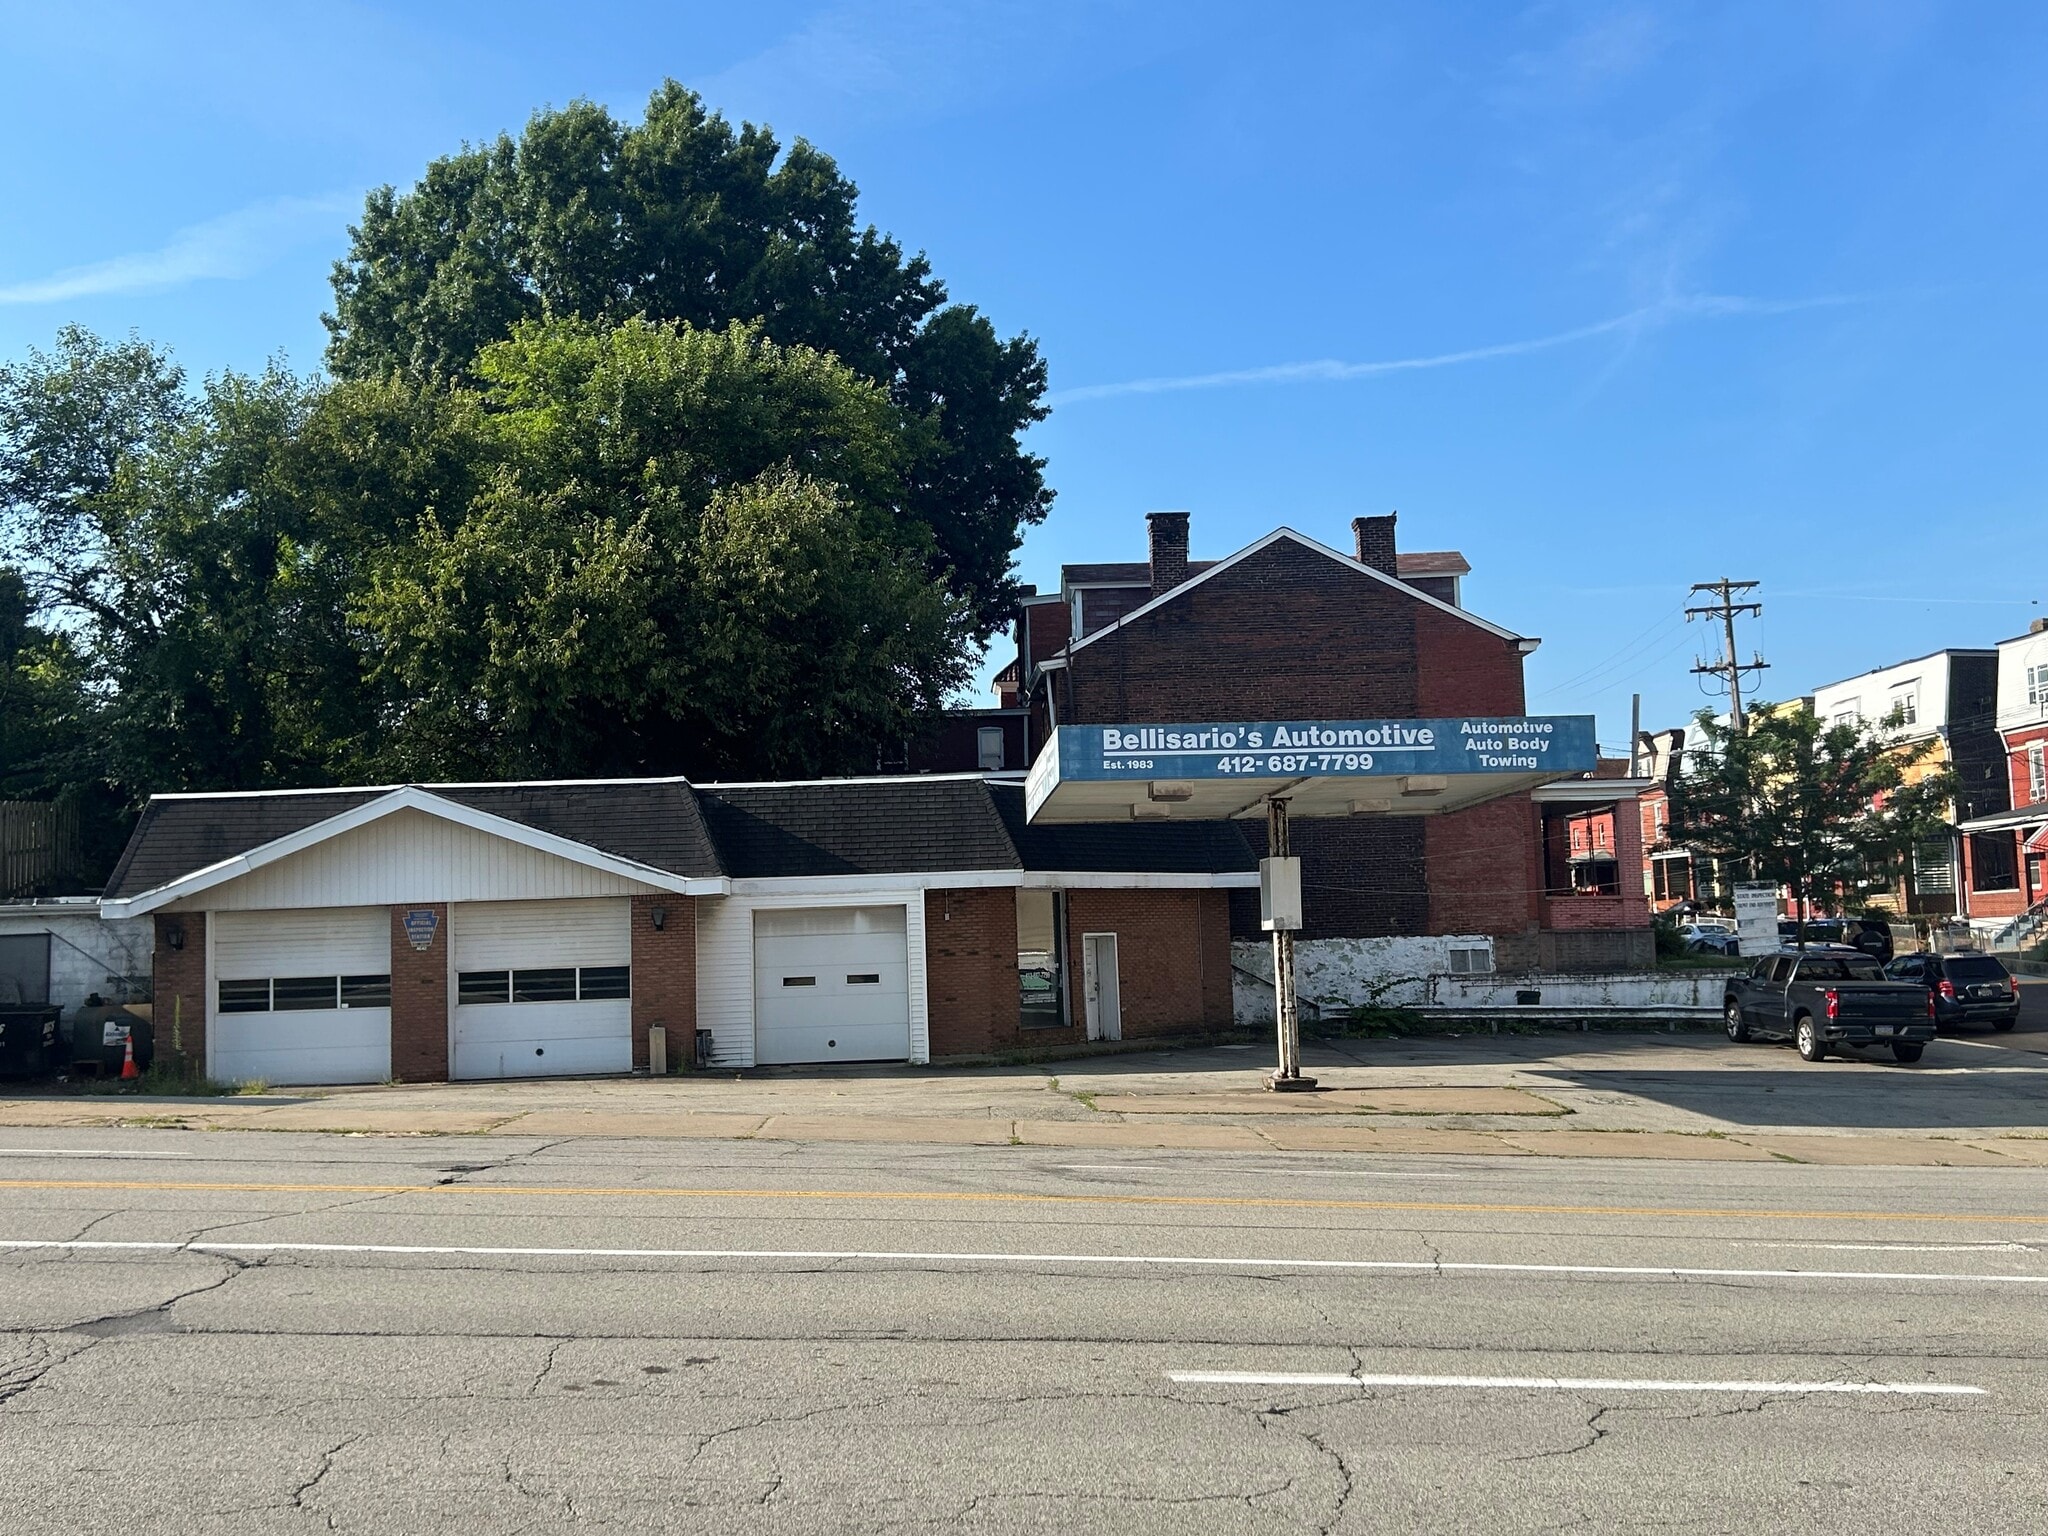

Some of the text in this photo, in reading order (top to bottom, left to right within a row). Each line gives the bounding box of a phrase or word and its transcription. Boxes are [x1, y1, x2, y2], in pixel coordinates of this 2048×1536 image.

[1460, 721, 1553, 734] Automotive
[1102, 724, 1434, 750] Bellisario's Automotive
[1465, 737, 1550, 752] Auto Body
[1103, 760, 1154, 769] Est. 1983
[1478, 754, 1537, 769] Towing
